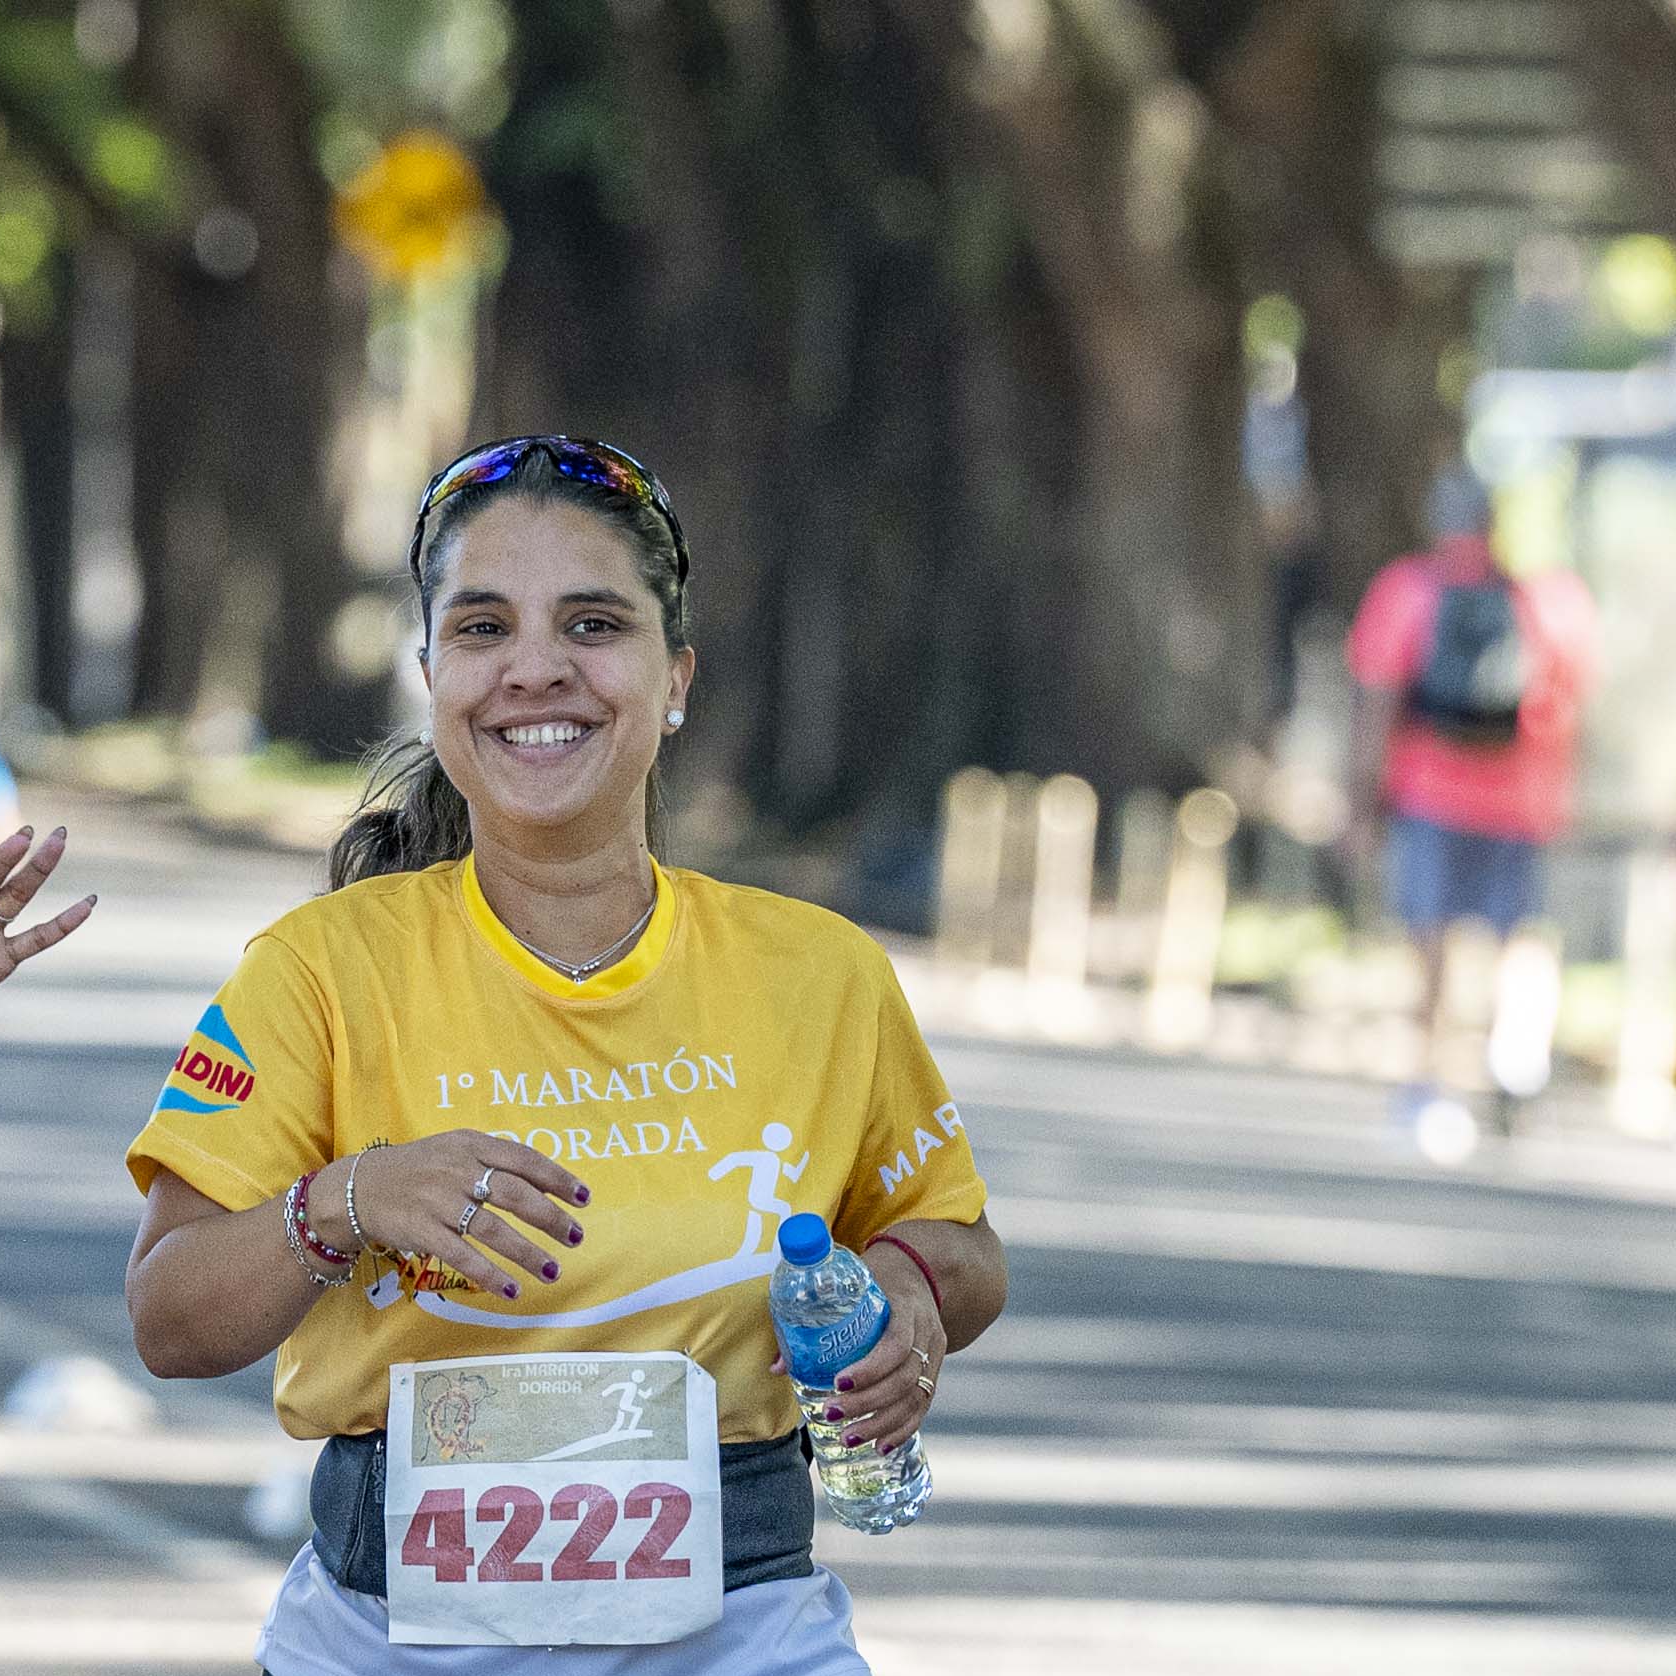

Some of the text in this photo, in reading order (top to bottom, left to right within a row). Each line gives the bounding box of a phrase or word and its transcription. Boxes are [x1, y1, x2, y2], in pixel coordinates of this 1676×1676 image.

[488, 1045, 738, 1108] MARATÓN
[819, 1302, 871, 1352] Sierra
[518, 1380, 583, 1394] DORADA
[401, 1481, 693, 1583] 4222
